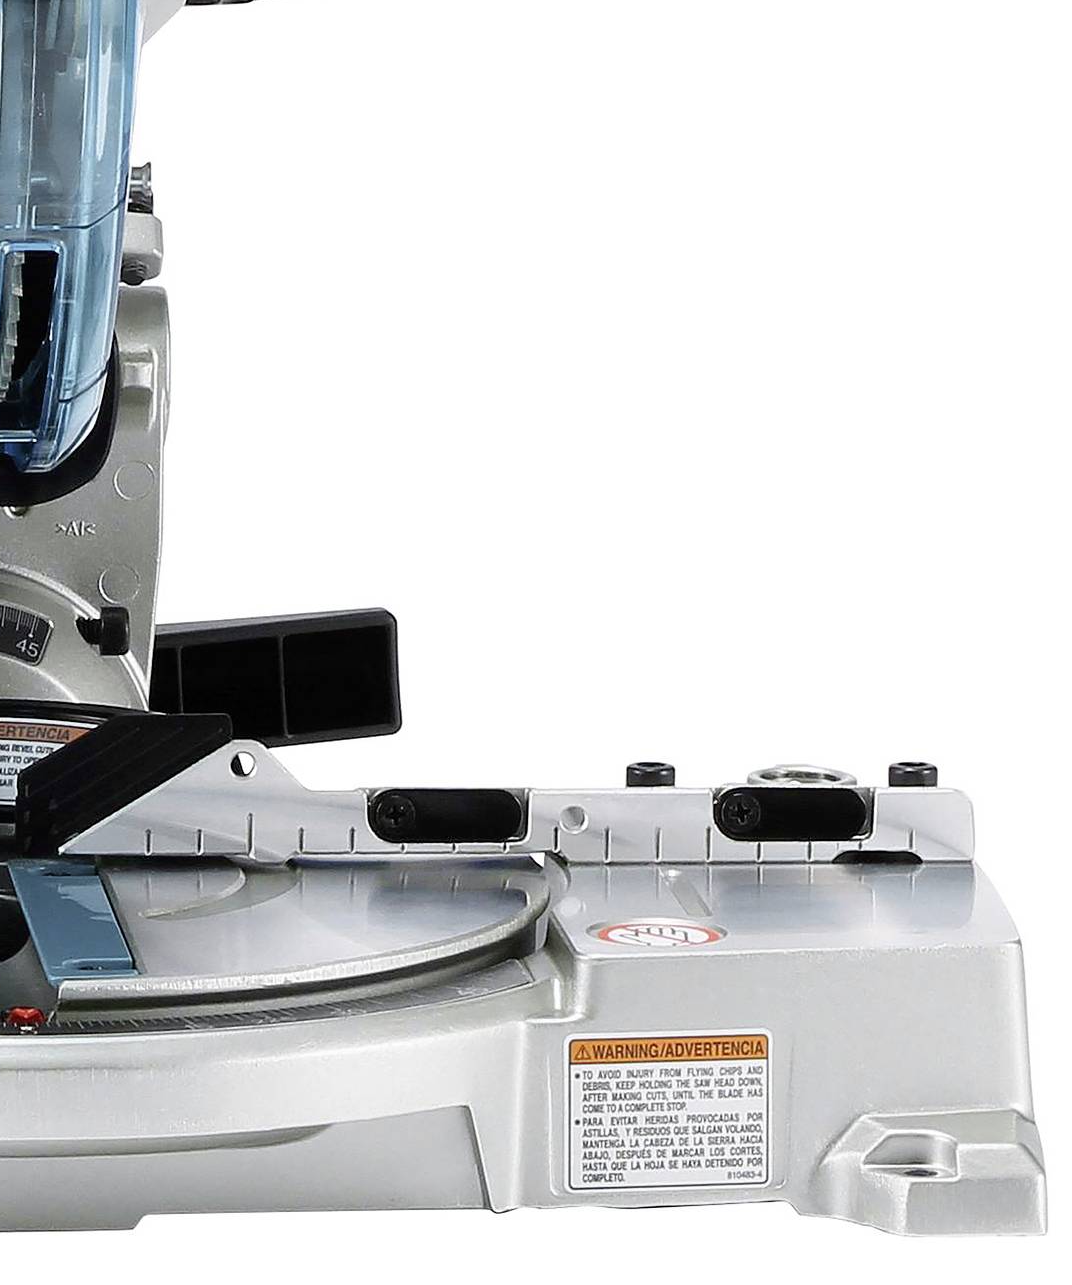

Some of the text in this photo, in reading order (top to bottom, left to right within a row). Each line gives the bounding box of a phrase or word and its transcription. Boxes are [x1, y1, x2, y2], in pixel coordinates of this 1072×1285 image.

[16, 637, 39, 657] 45
[592, 1042, 764, 1059] WARNING/ADVERTENCIA
[583, 1066, 763, 1080] TO AVOID INJURY FROM FLYING CHIPS AND
[616, 1081, 635, 1090] KEEP
[639, 1079, 672, 1090] HOLDING
[676, 1079, 690, 1088] THE
[695, 1079, 710, 1087] SAW
[714, 1078, 734, 1087] HEAD
[583, 1093, 607, 1102] AFTER
[612, 1092, 641, 1101] MAKING
[673, 1091, 694, 1099] UNTIL
[699, 1090, 713, 1098] THE
[718, 1089, 743, 1098] BLADE
[747, 1088, 763, 1097] HAS
[583, 1102, 687, 1113] COME TO A COMPLETE STOP.
[583, 1113, 763, 1126] PARA EVITAR HERIDAS PROVOCADAS POR
[626, 1128, 630, 1136] Y
[633, 1126, 670, 1136] RESIDUOS
[674, 1126, 689, 1135] QUE
[692, 1125, 722, 1134] SALGAN
[583, 1140, 625, 1148] MANTENGA
[630, 1138, 639, 1148] LA
[644, 1137, 674, 1147] CABEZA
[679, 1137, 689, 1146] DE
[694, 1137, 704, 1145] LA
[708, 1136, 735, 1145] SIERRA
[583, 1151, 611, 1160] ABAJO,
[657, 1149, 666, 1158] DE
[672, 1148, 705, 1157] MARCAR
[710, 1147, 725, 1156] LOS
[583, 1157, 762, 1171] HASTA QUE LA HOJA SE HAYA DETENIDO POR
[583, 1173, 625, 1182] COMPLETO.
